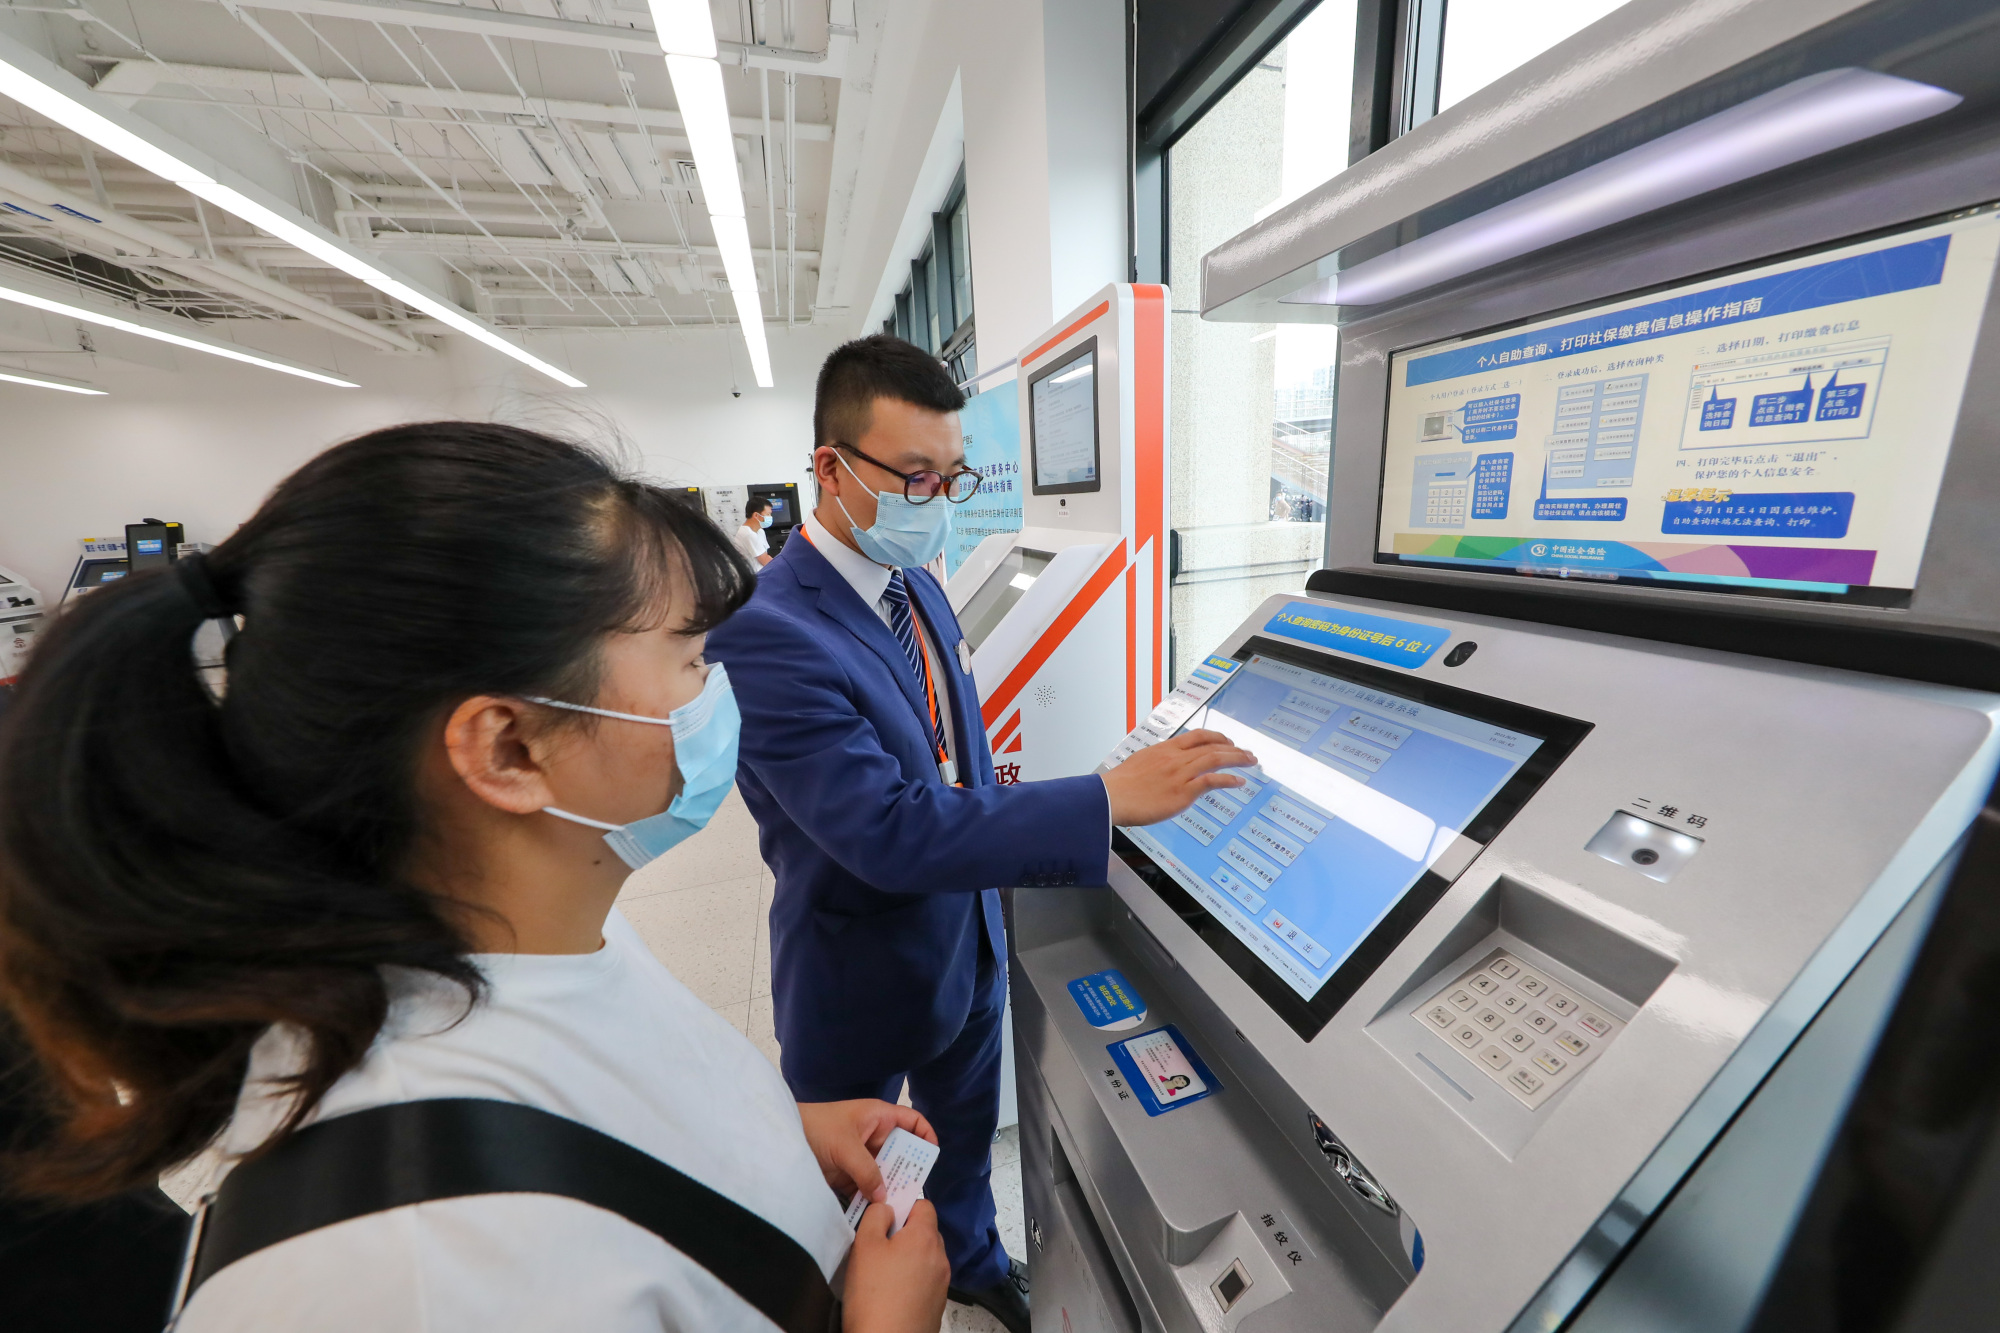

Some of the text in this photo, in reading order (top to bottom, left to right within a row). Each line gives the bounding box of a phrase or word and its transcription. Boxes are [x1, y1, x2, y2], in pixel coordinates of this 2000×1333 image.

[1476, 296, 1764, 369] 个人自助查询、打印社保缴费信息操作指南
[1758, 395, 1788, 406] 第二步
[1823, 398, 1846, 409] 点击
[1825, 387, 1860, 399] 第三步
[1704, 410, 1732, 420] 选择查
[1706, 401, 1733, 412] 第一步
[1819, 405, 1858, 418] 【打印】
[1703, 419, 1730, 428] 询日期
[1665, 487, 1734, 504] 温馨提示
[1551, 544, 1607, 556] 中国社会保险
[1277, 612, 1433, 654] 个人查询密码为身份证号后6位！
[1310, 676, 1420, 717] 社保卡用户自助服务系统
[1631, 797, 1708, 829] 二维码
[1479, 981, 1546, 1026] 4 5 6
[1525, 981, 1538, 991] 2
[1555, 999, 1567, 1009] 3
[1458, 995, 1524, 1043] 7 8 9
[1104, 1069, 1130, 1101] 身份证
[1260, 1213, 1302, 1266] 指纹仪
